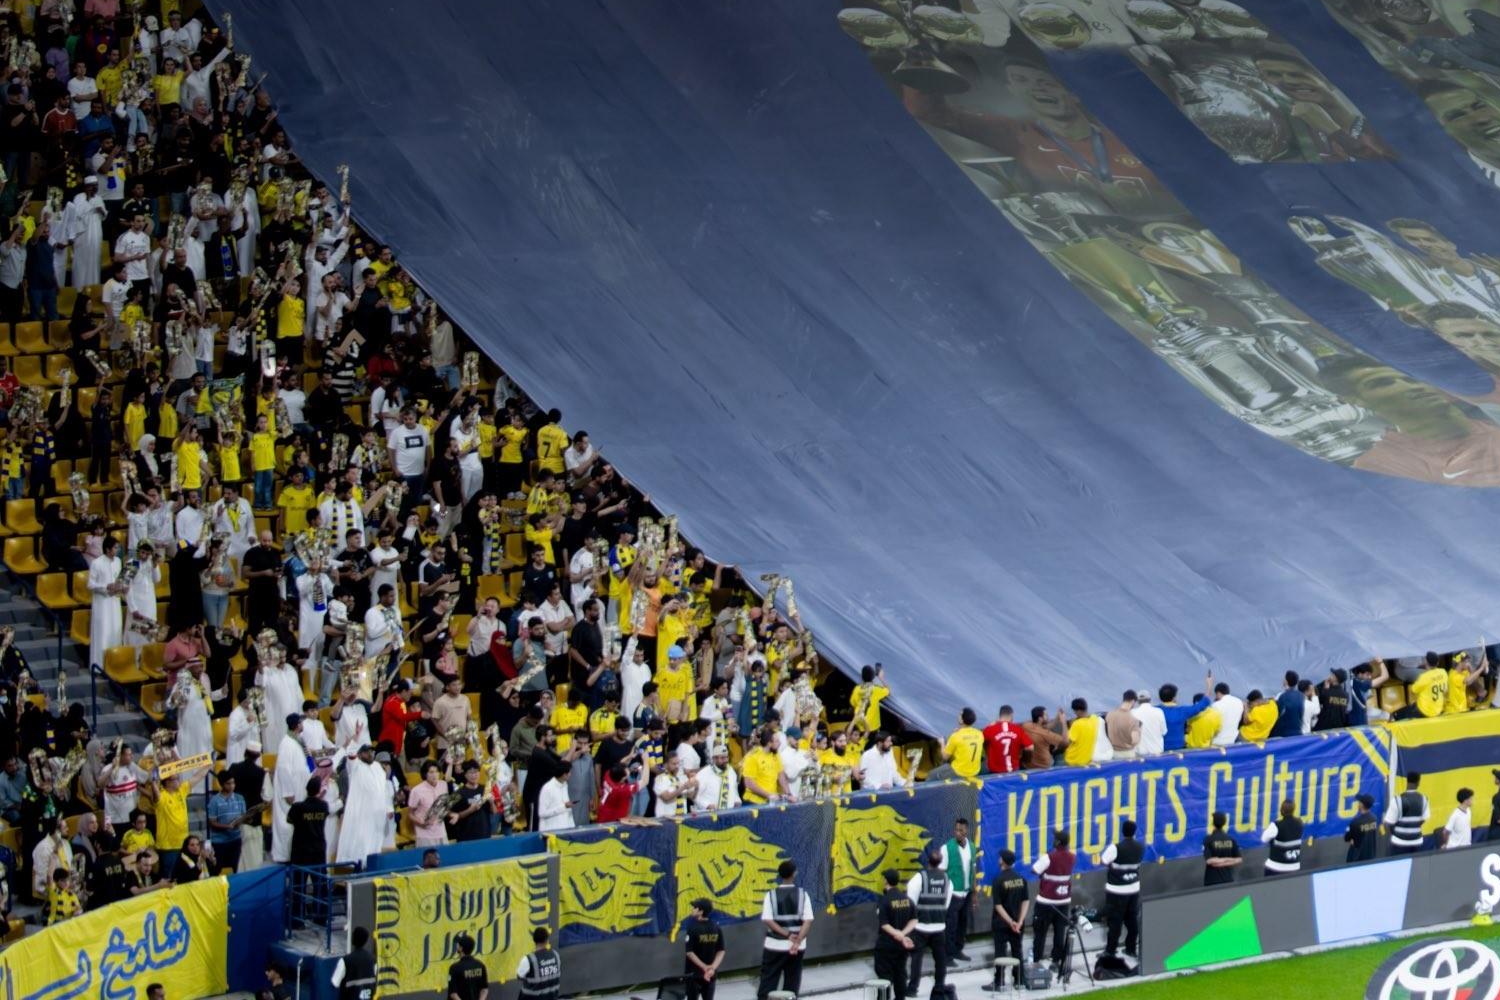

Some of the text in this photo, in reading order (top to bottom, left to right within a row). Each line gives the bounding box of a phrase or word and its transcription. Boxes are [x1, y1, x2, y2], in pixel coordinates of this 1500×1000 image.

[969, 742, 978, 763] 7
[1001, 738, 1012, 756] 7
[1007, 754, 1362, 864] KNIGHTS Culture
[1003, 878, 1025, 889] POLICE
[464, 968, 483, 979] POLICE
